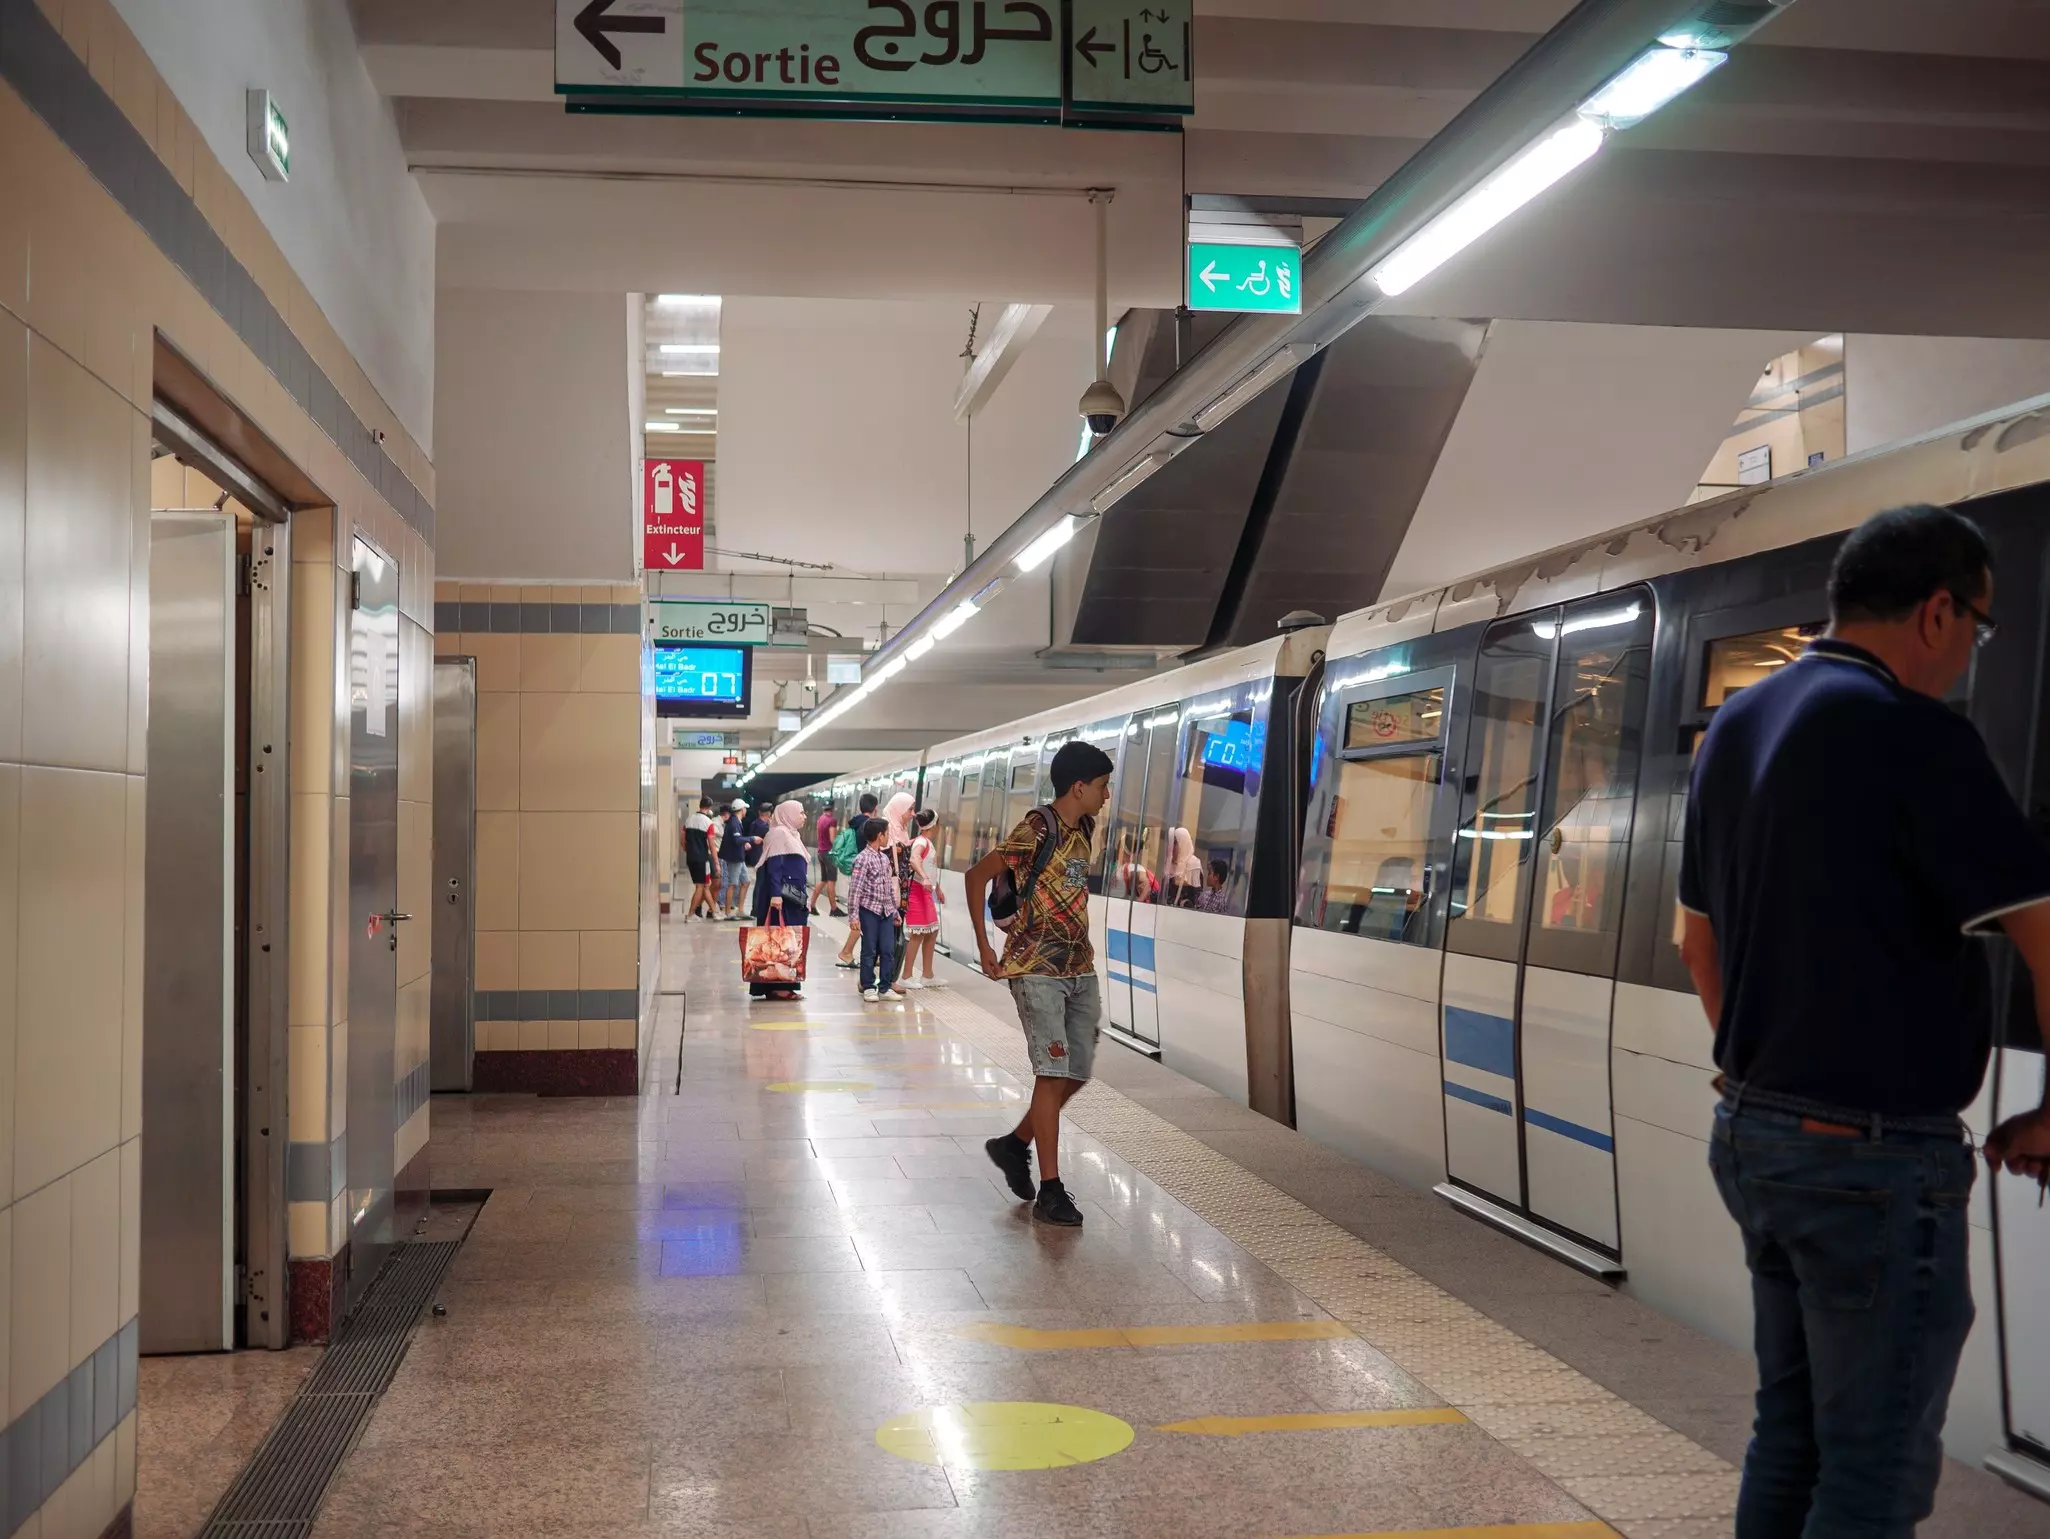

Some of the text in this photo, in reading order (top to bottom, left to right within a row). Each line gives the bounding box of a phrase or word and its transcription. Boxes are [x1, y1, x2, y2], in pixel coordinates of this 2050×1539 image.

[693, 42, 840, 86] Sortie
[646, 524, 701, 535] Extincteur
[662, 625, 704, 638] Sortie
[707, 607, 765, 634] خروج
[701, 672, 736, 696] 07
